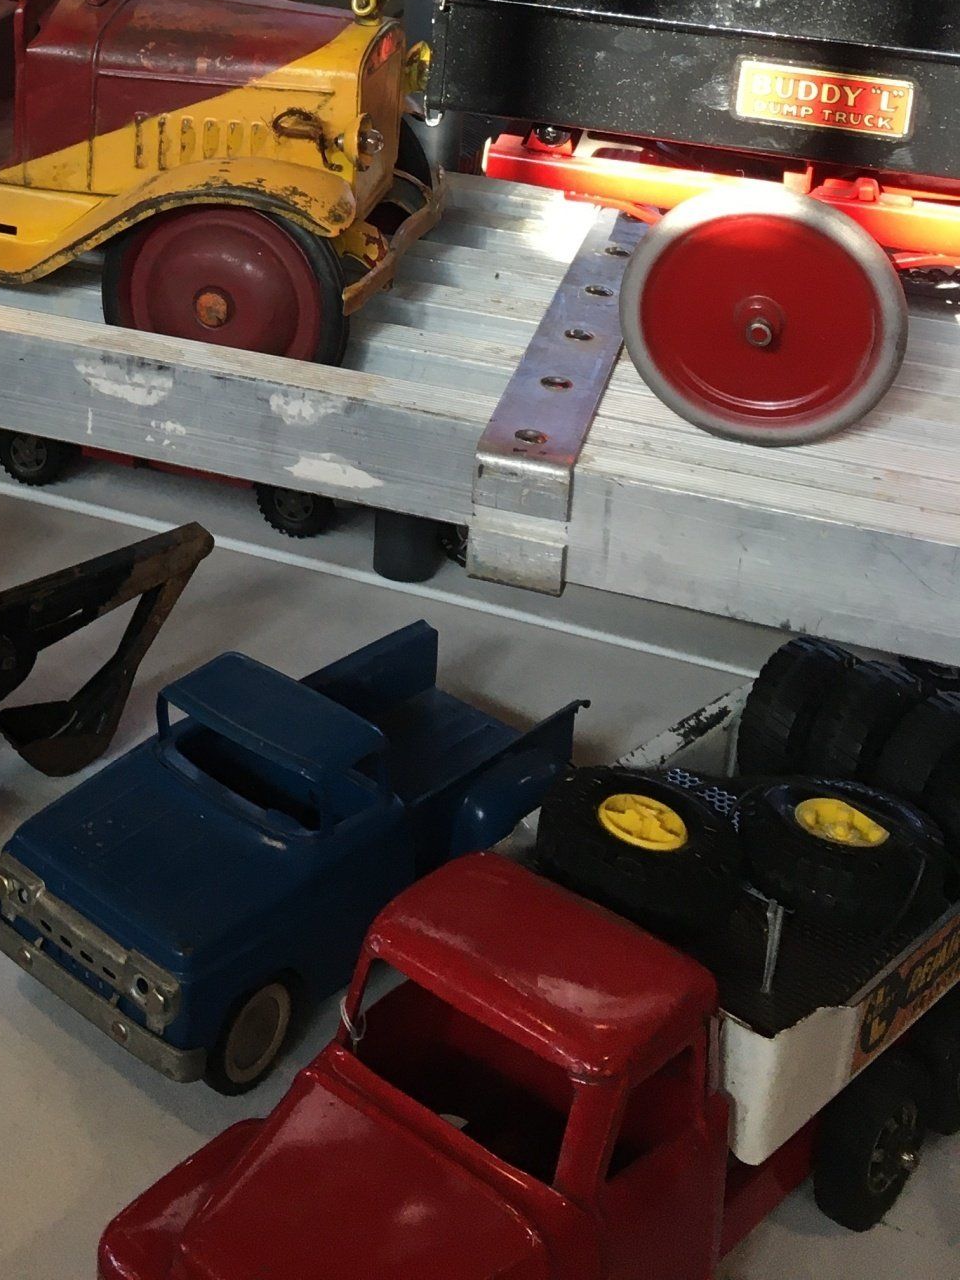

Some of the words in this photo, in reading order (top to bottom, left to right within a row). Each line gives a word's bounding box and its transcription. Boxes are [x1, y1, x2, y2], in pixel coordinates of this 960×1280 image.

[751, 73, 865, 107] BUDDY
[753, 100, 814, 119] DUMP
[822, 108, 895, 130] TRUCK
